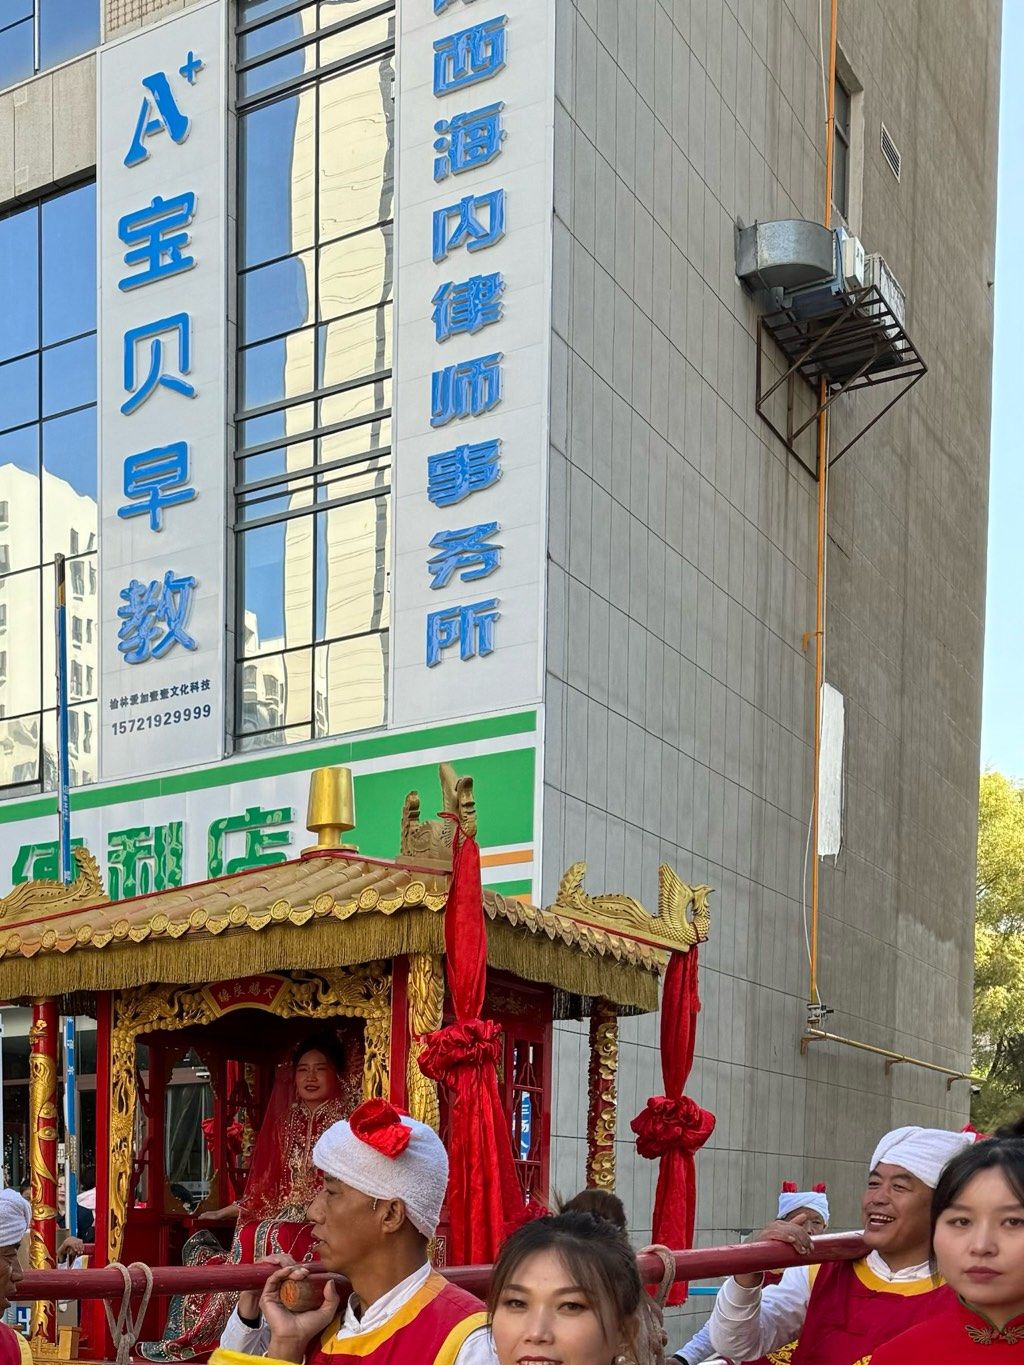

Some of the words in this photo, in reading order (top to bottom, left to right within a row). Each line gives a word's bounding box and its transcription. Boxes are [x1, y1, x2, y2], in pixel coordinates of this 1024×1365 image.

[426, 0, 508, 668] 西海内律师事务所
[112, 704, 211, 735] 15721929999
